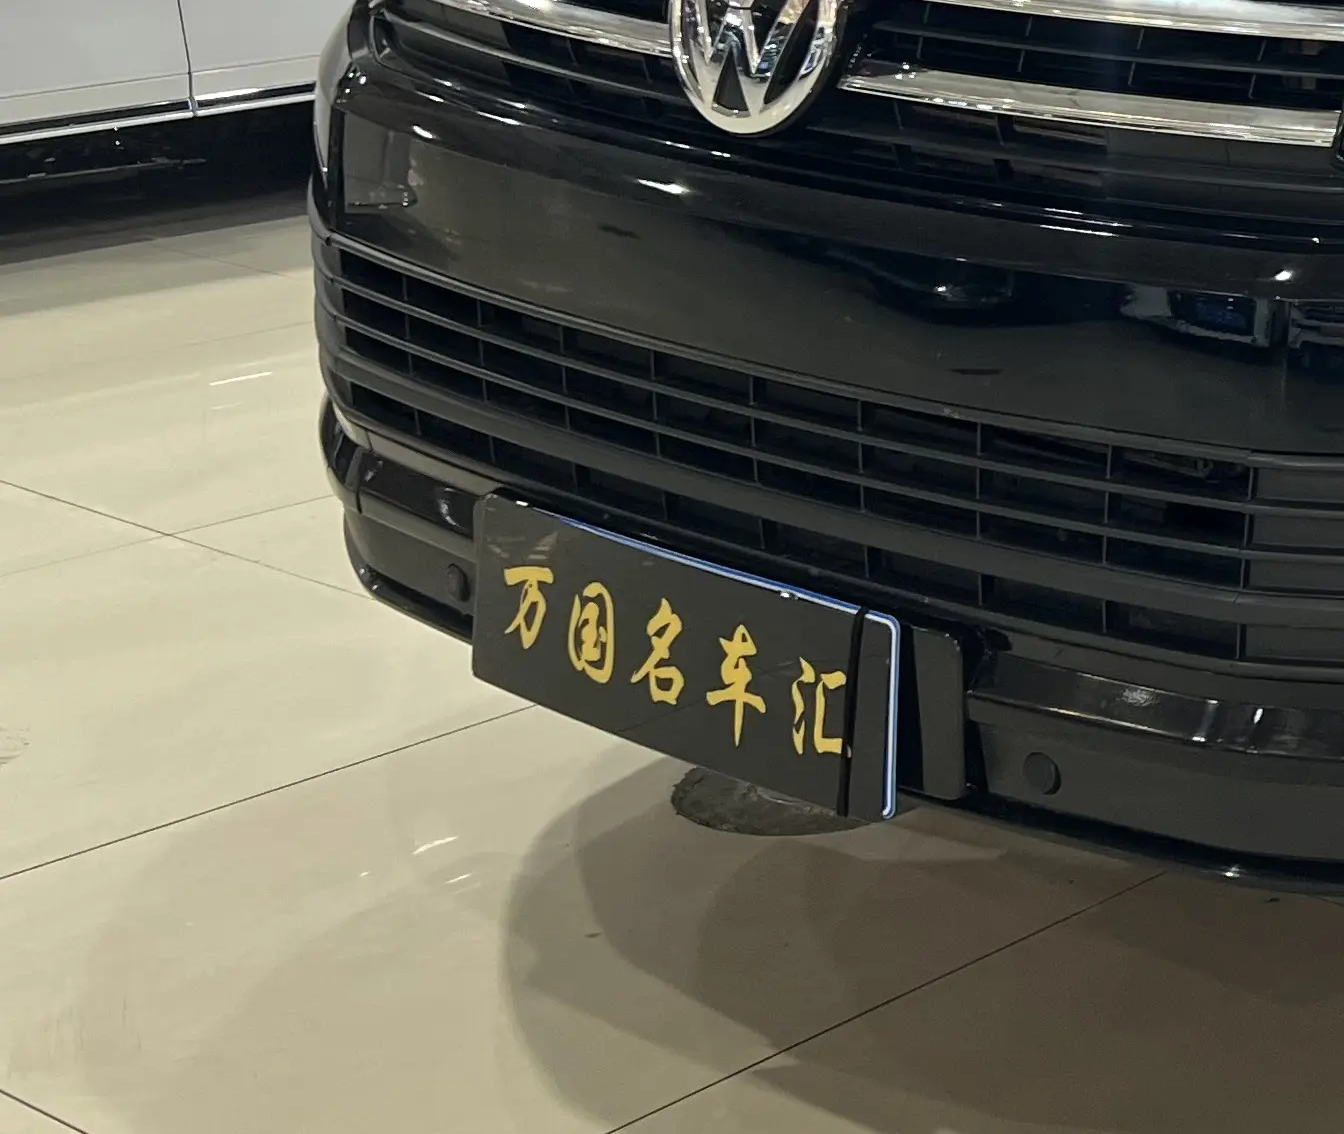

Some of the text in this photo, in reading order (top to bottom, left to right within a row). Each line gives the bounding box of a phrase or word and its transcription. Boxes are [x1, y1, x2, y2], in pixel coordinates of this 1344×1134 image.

[503, 566, 848, 755] 万国名车汇
